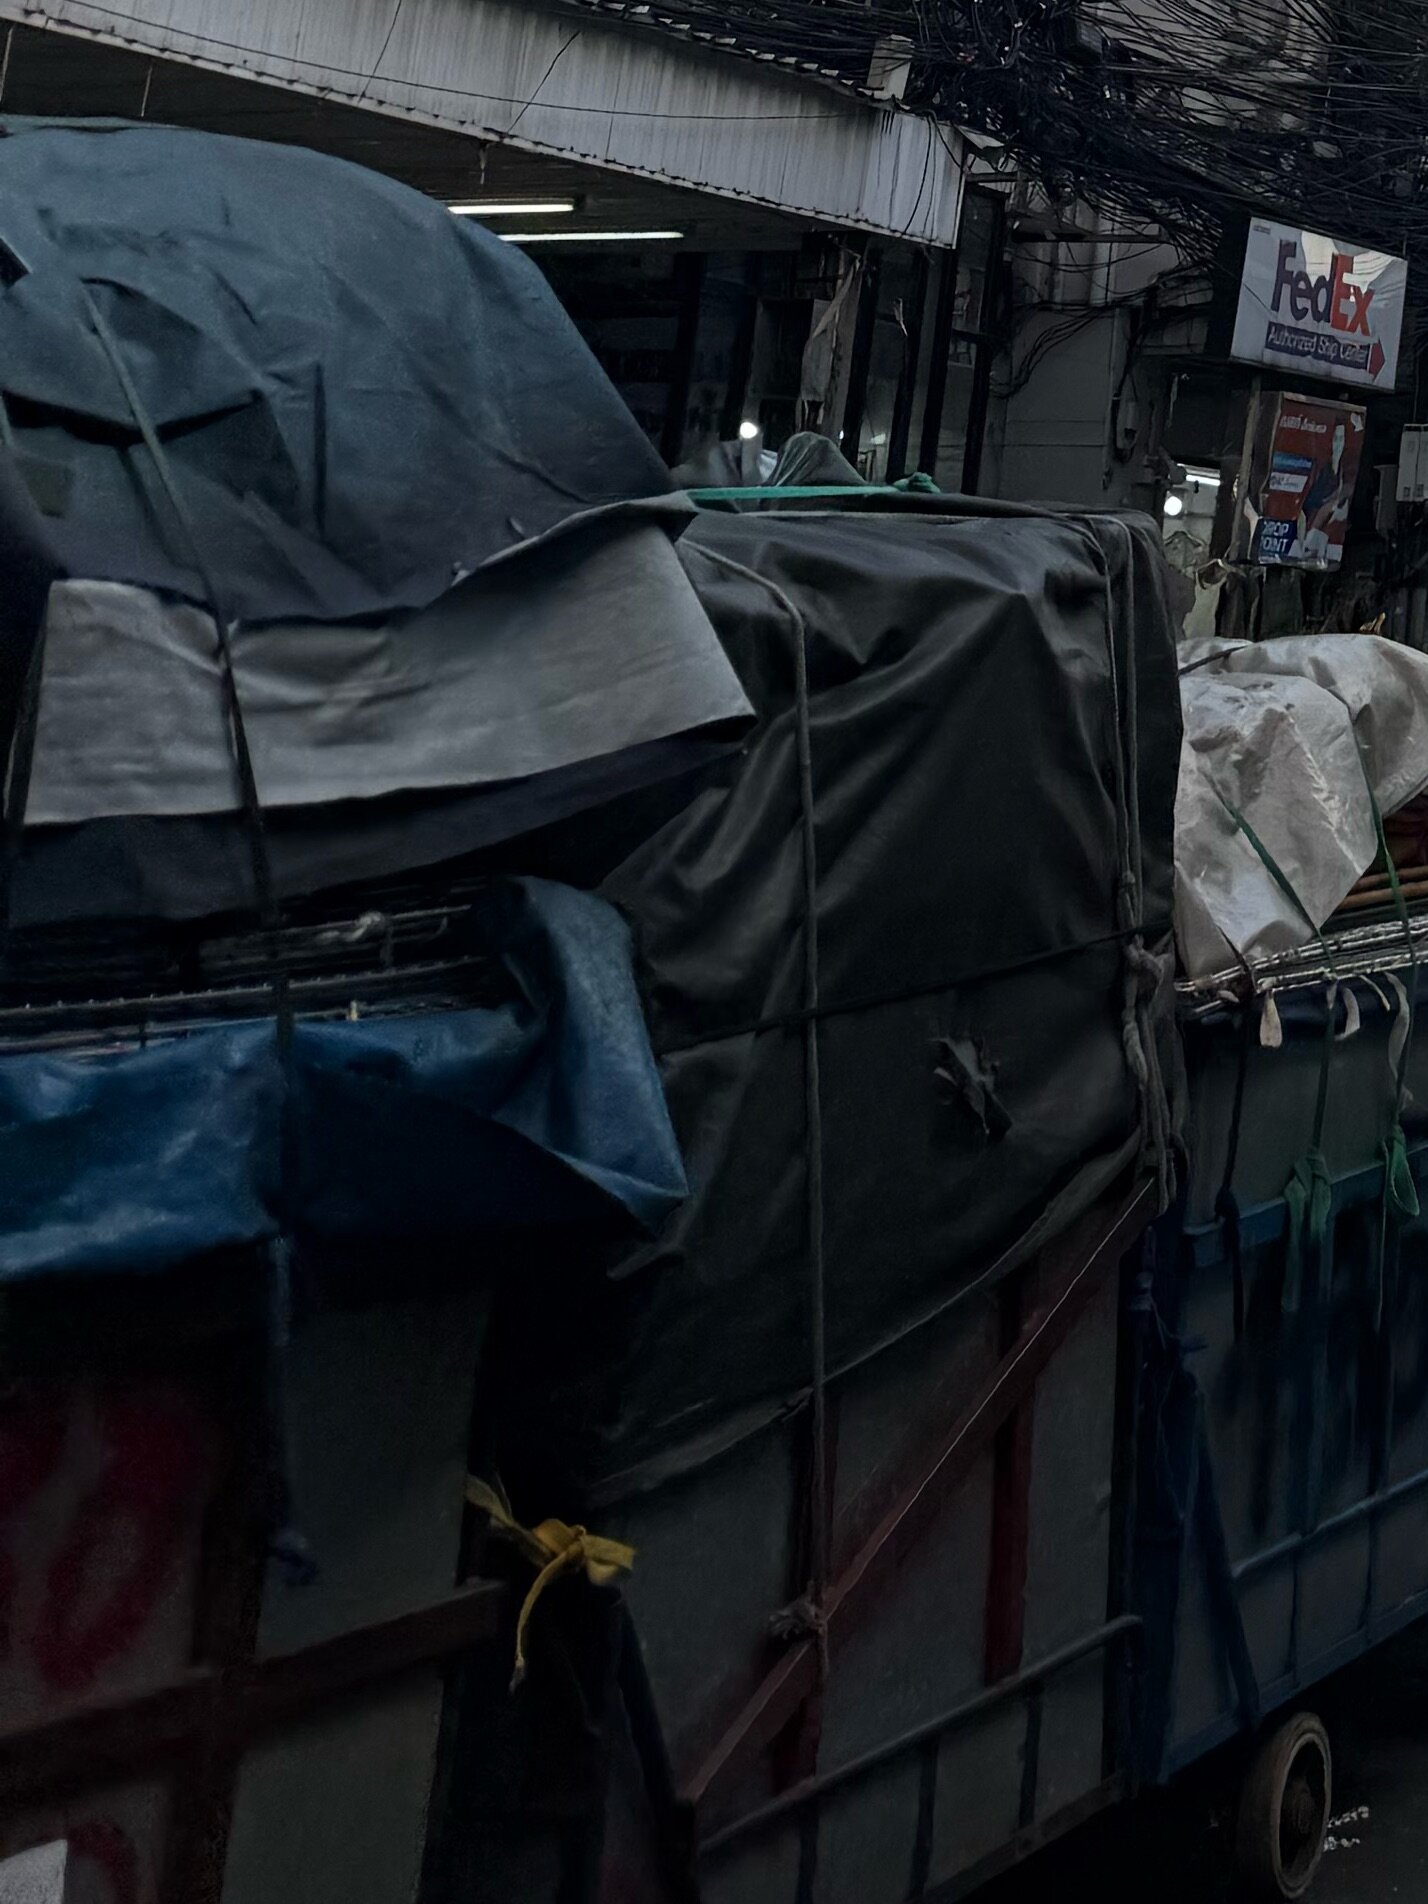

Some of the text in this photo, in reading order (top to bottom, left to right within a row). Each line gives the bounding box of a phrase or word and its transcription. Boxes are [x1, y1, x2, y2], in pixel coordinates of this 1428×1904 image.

[1270, 239, 1375, 337] FedEx
[1268, 324, 1317, 353] Authorized
[1318, 334, 1338, 361] Ship
[1261, 535, 1288, 553] OINT
